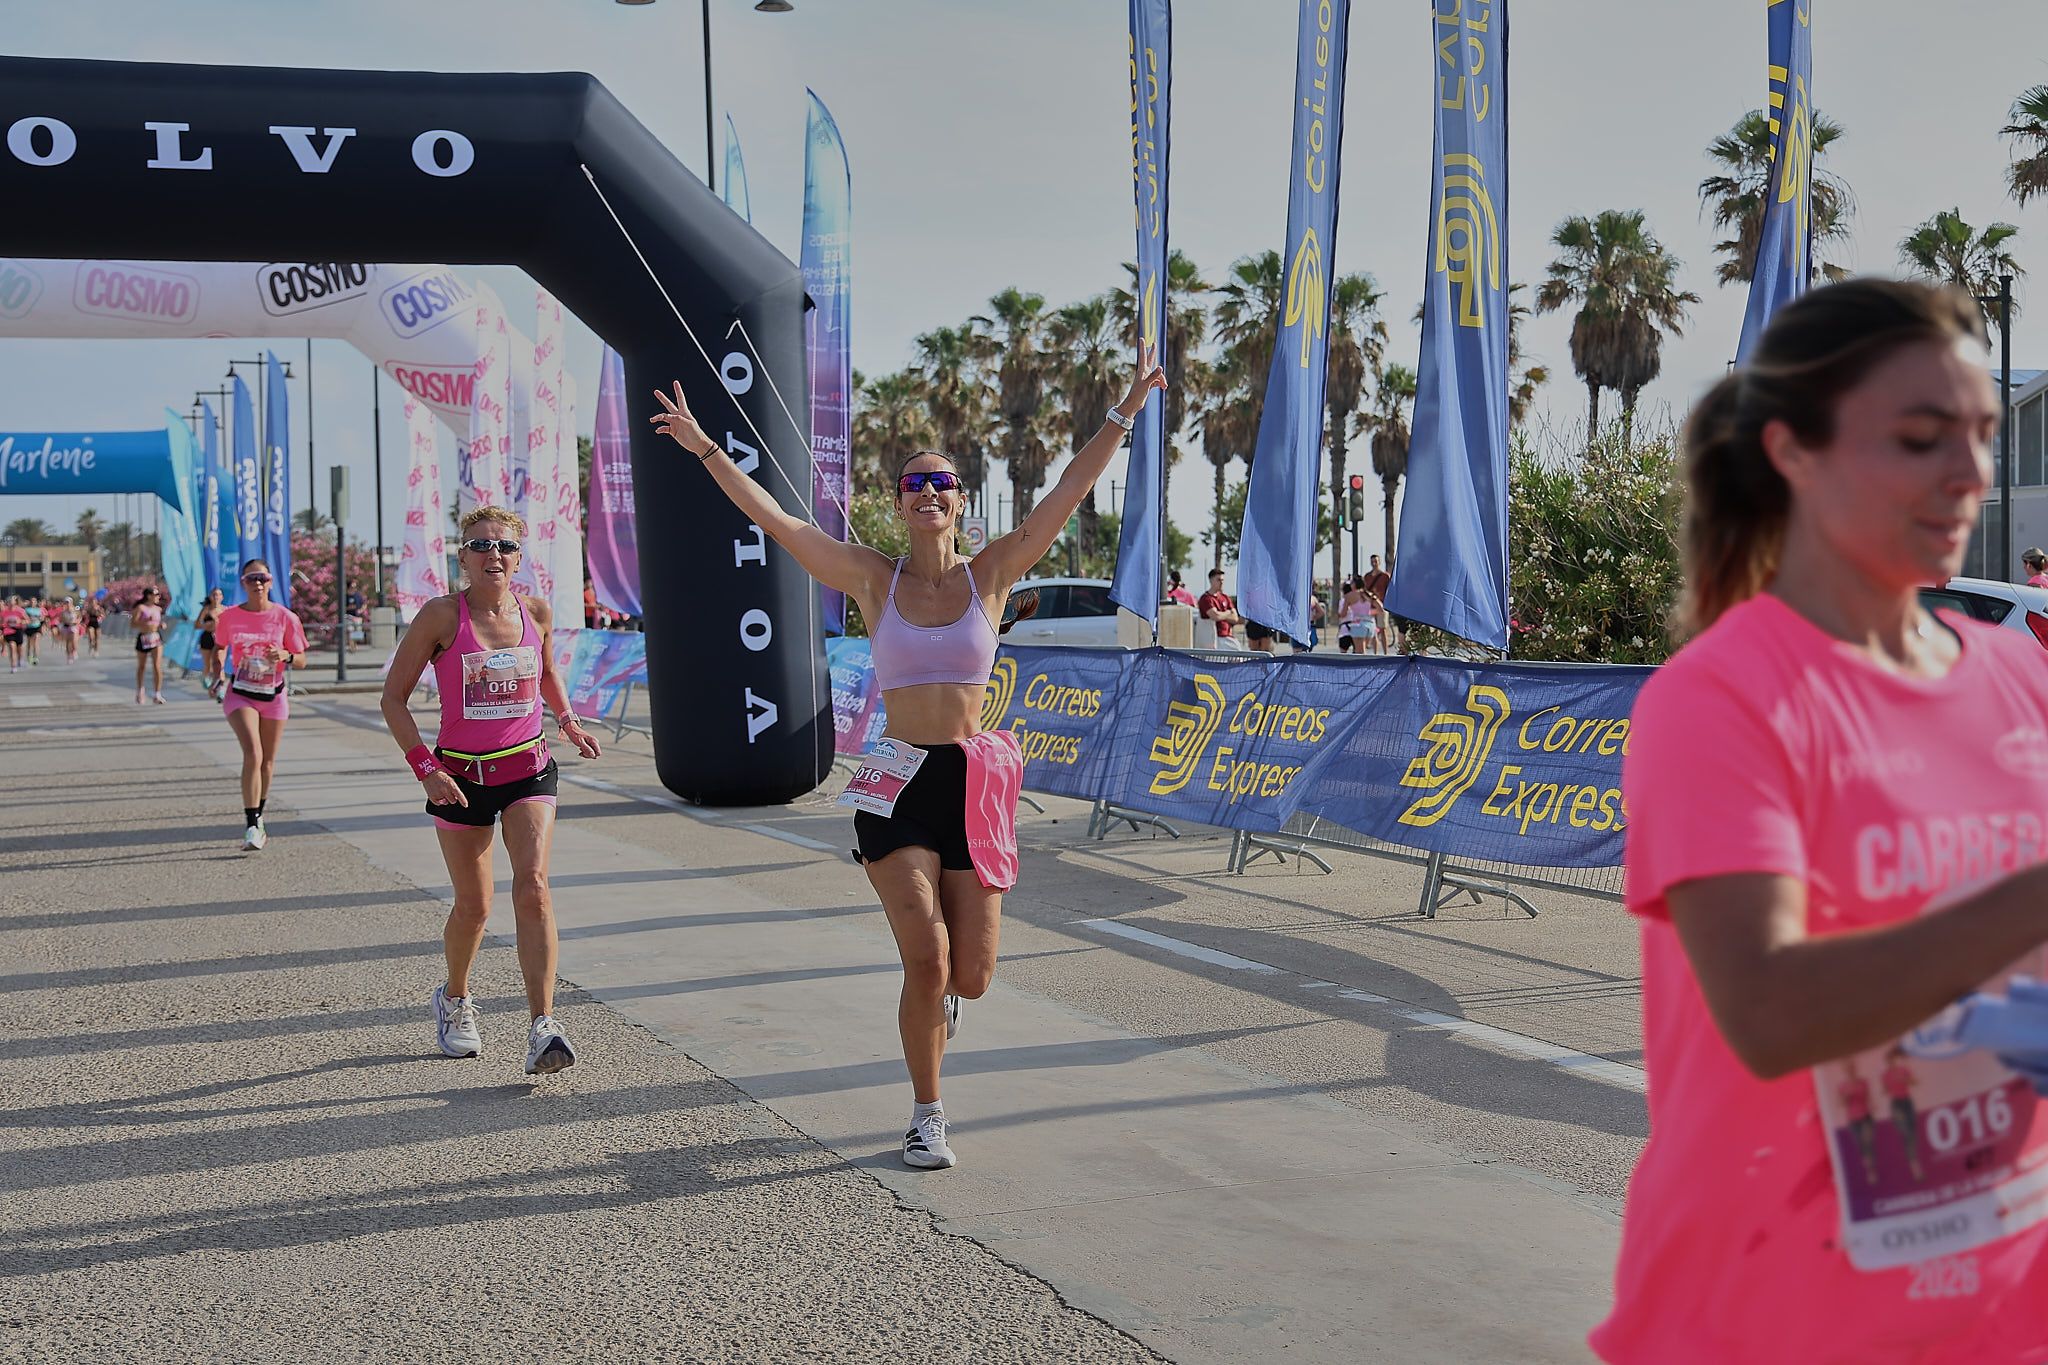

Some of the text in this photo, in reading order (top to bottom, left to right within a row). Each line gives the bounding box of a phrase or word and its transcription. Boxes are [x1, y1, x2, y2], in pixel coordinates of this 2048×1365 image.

[6, 115, 476, 178] OLVO
[85, 267, 190, 318] COSMO
[269, 263, 366, 307] COSMO
[391, 271, 473, 328] COSM
[395, 367, 475, 406] COSM
[488, 679, 518, 693] 016
[1023, 674, 1103, 718] Correos
[1229, 692, 1330, 743] Correos
[855, 768, 883, 783] 016
[1927, 1090, 2011, 1152] 016
[1882, 1212, 1971, 1248] OYSHO
[1907, 1255, 1981, 1299] 2026
